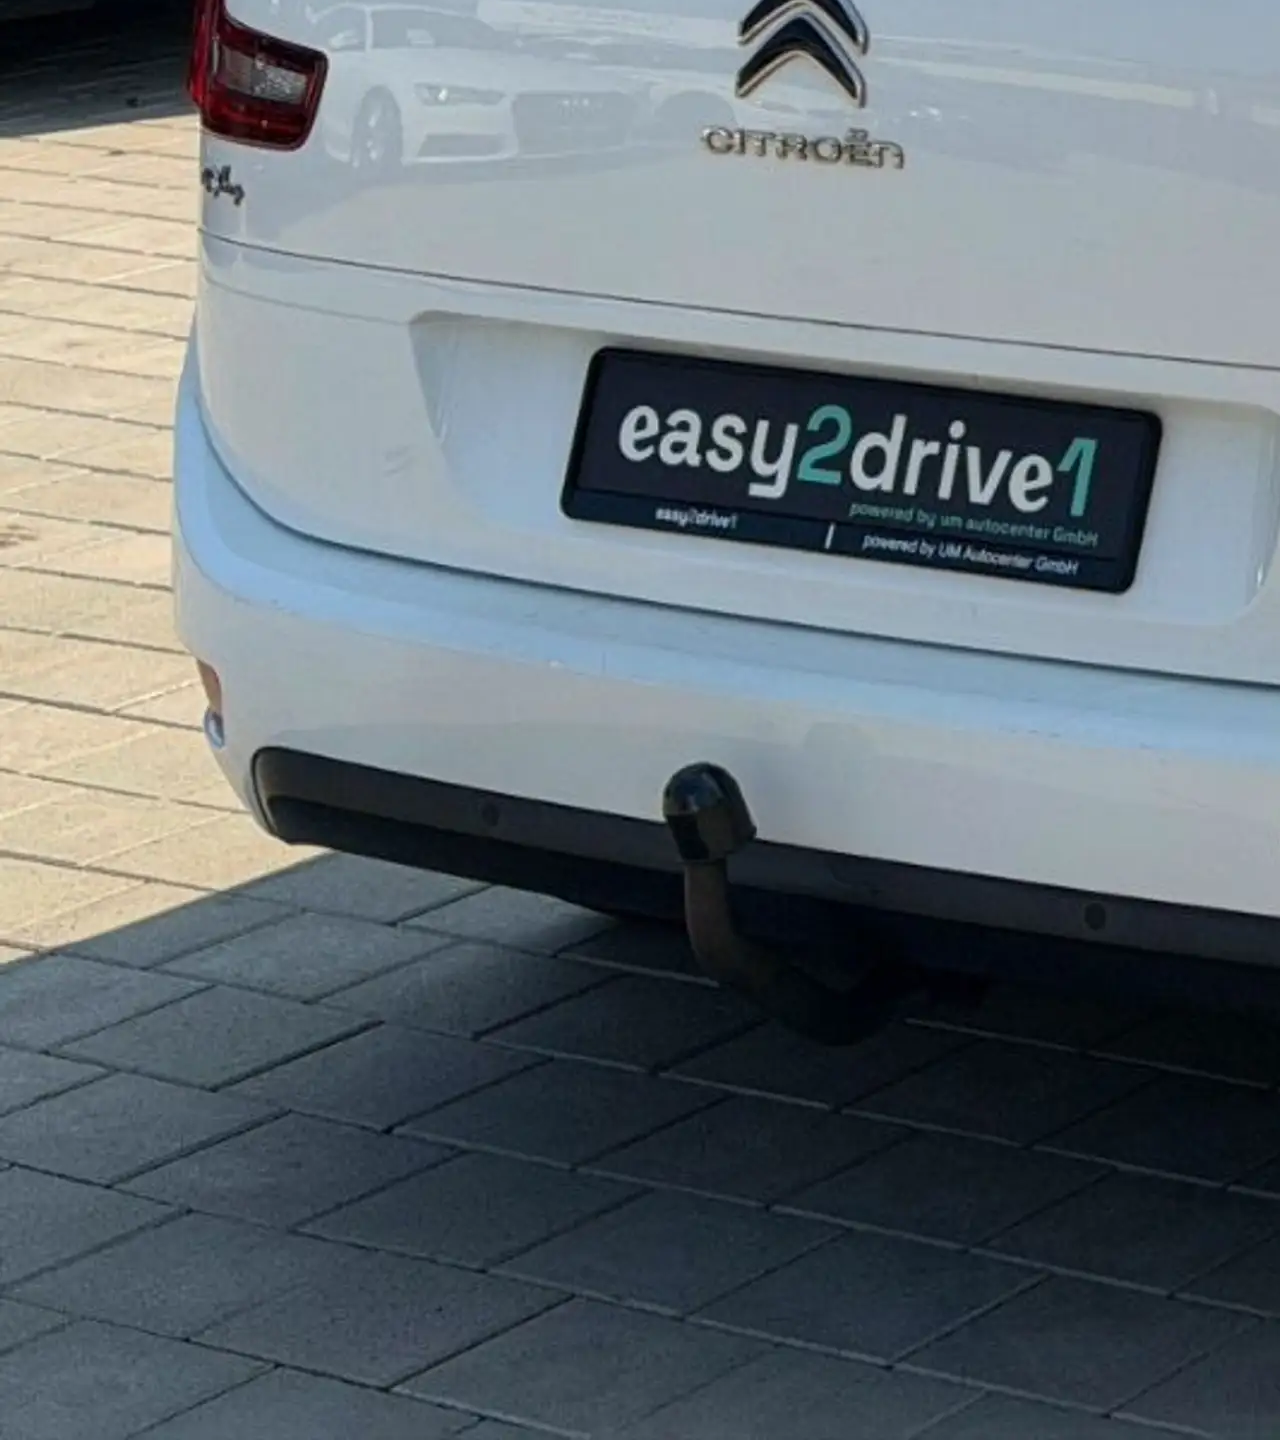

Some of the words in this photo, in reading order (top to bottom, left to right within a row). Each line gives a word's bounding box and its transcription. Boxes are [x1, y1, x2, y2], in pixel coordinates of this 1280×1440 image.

[618, 403, 1098, 517] easy2drive1
[849, 502, 914, 523] powered
[917, 508, 937, 527] by
[940, 513, 963, 529] um
[965, 517, 1051, 540] autocenter
[1051, 526, 1099, 548] GmbH
[861, 534, 918, 554] powered
[919, 540, 936, 558] by
[938, 541, 962, 558] UM
[963, 545, 1034, 569] Autocenter
[1034, 555, 1080, 576] GmbH
